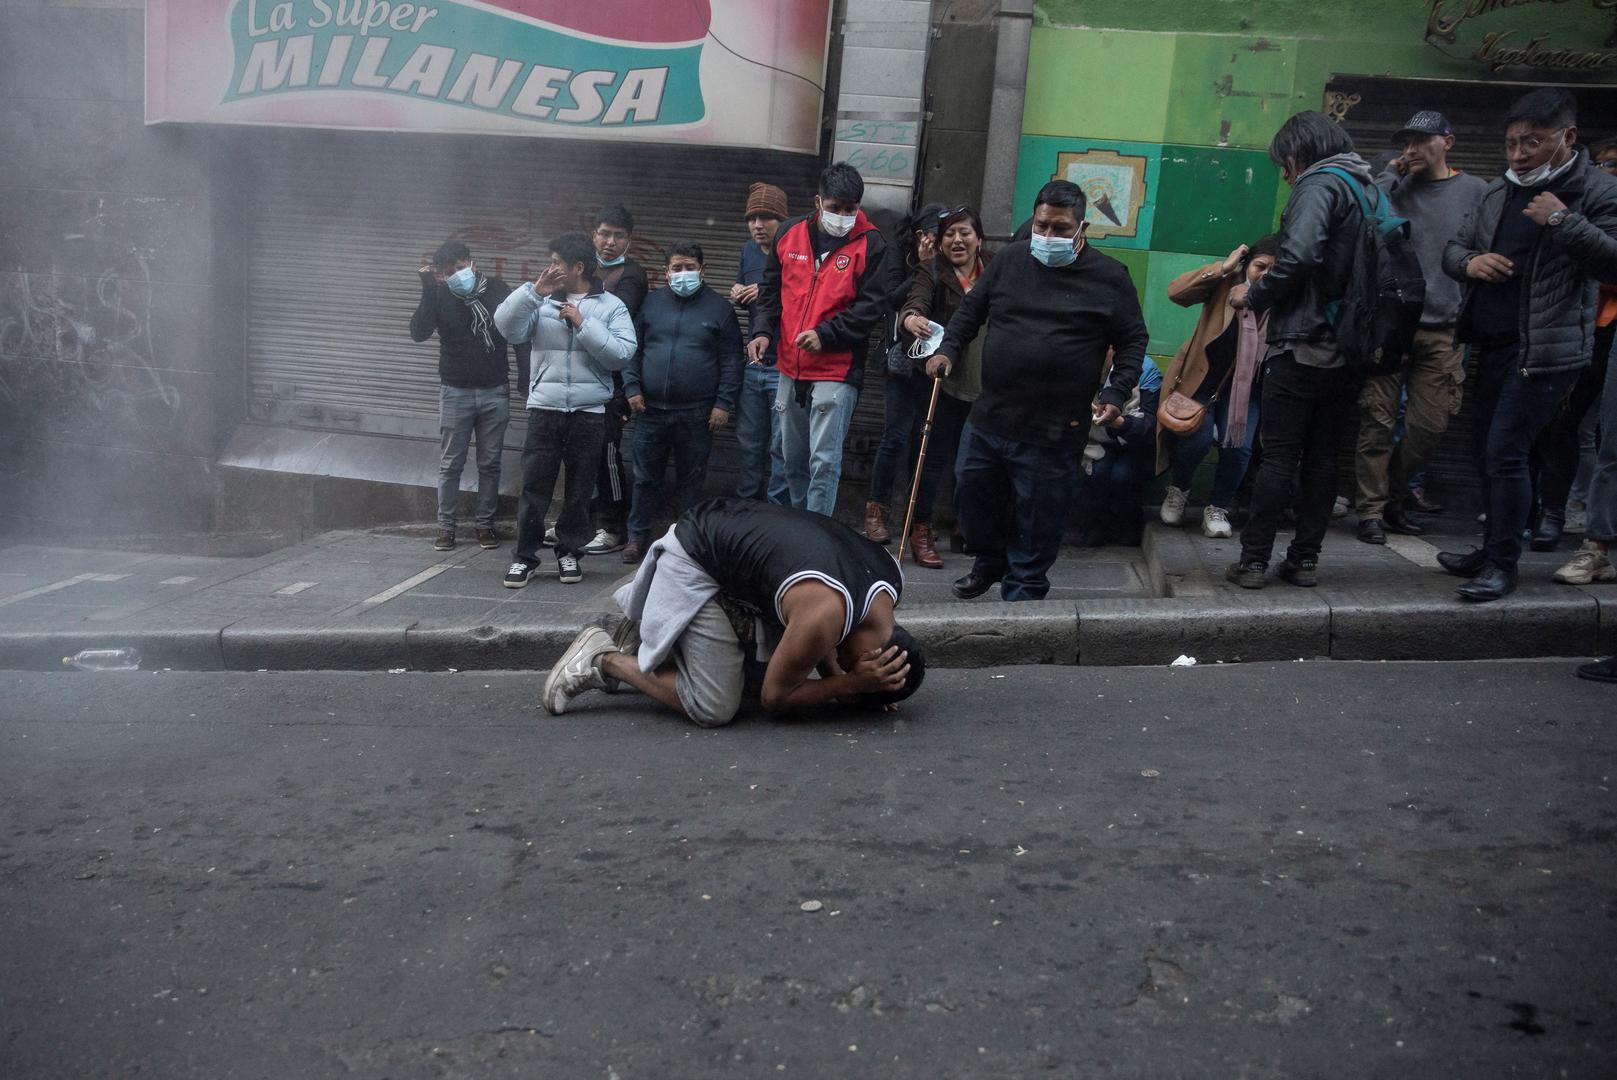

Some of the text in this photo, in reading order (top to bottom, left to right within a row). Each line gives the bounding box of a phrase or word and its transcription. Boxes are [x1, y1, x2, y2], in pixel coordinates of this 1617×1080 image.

[249, 0, 438, 36] La Super
[236, 34, 670, 125] MILANESA
